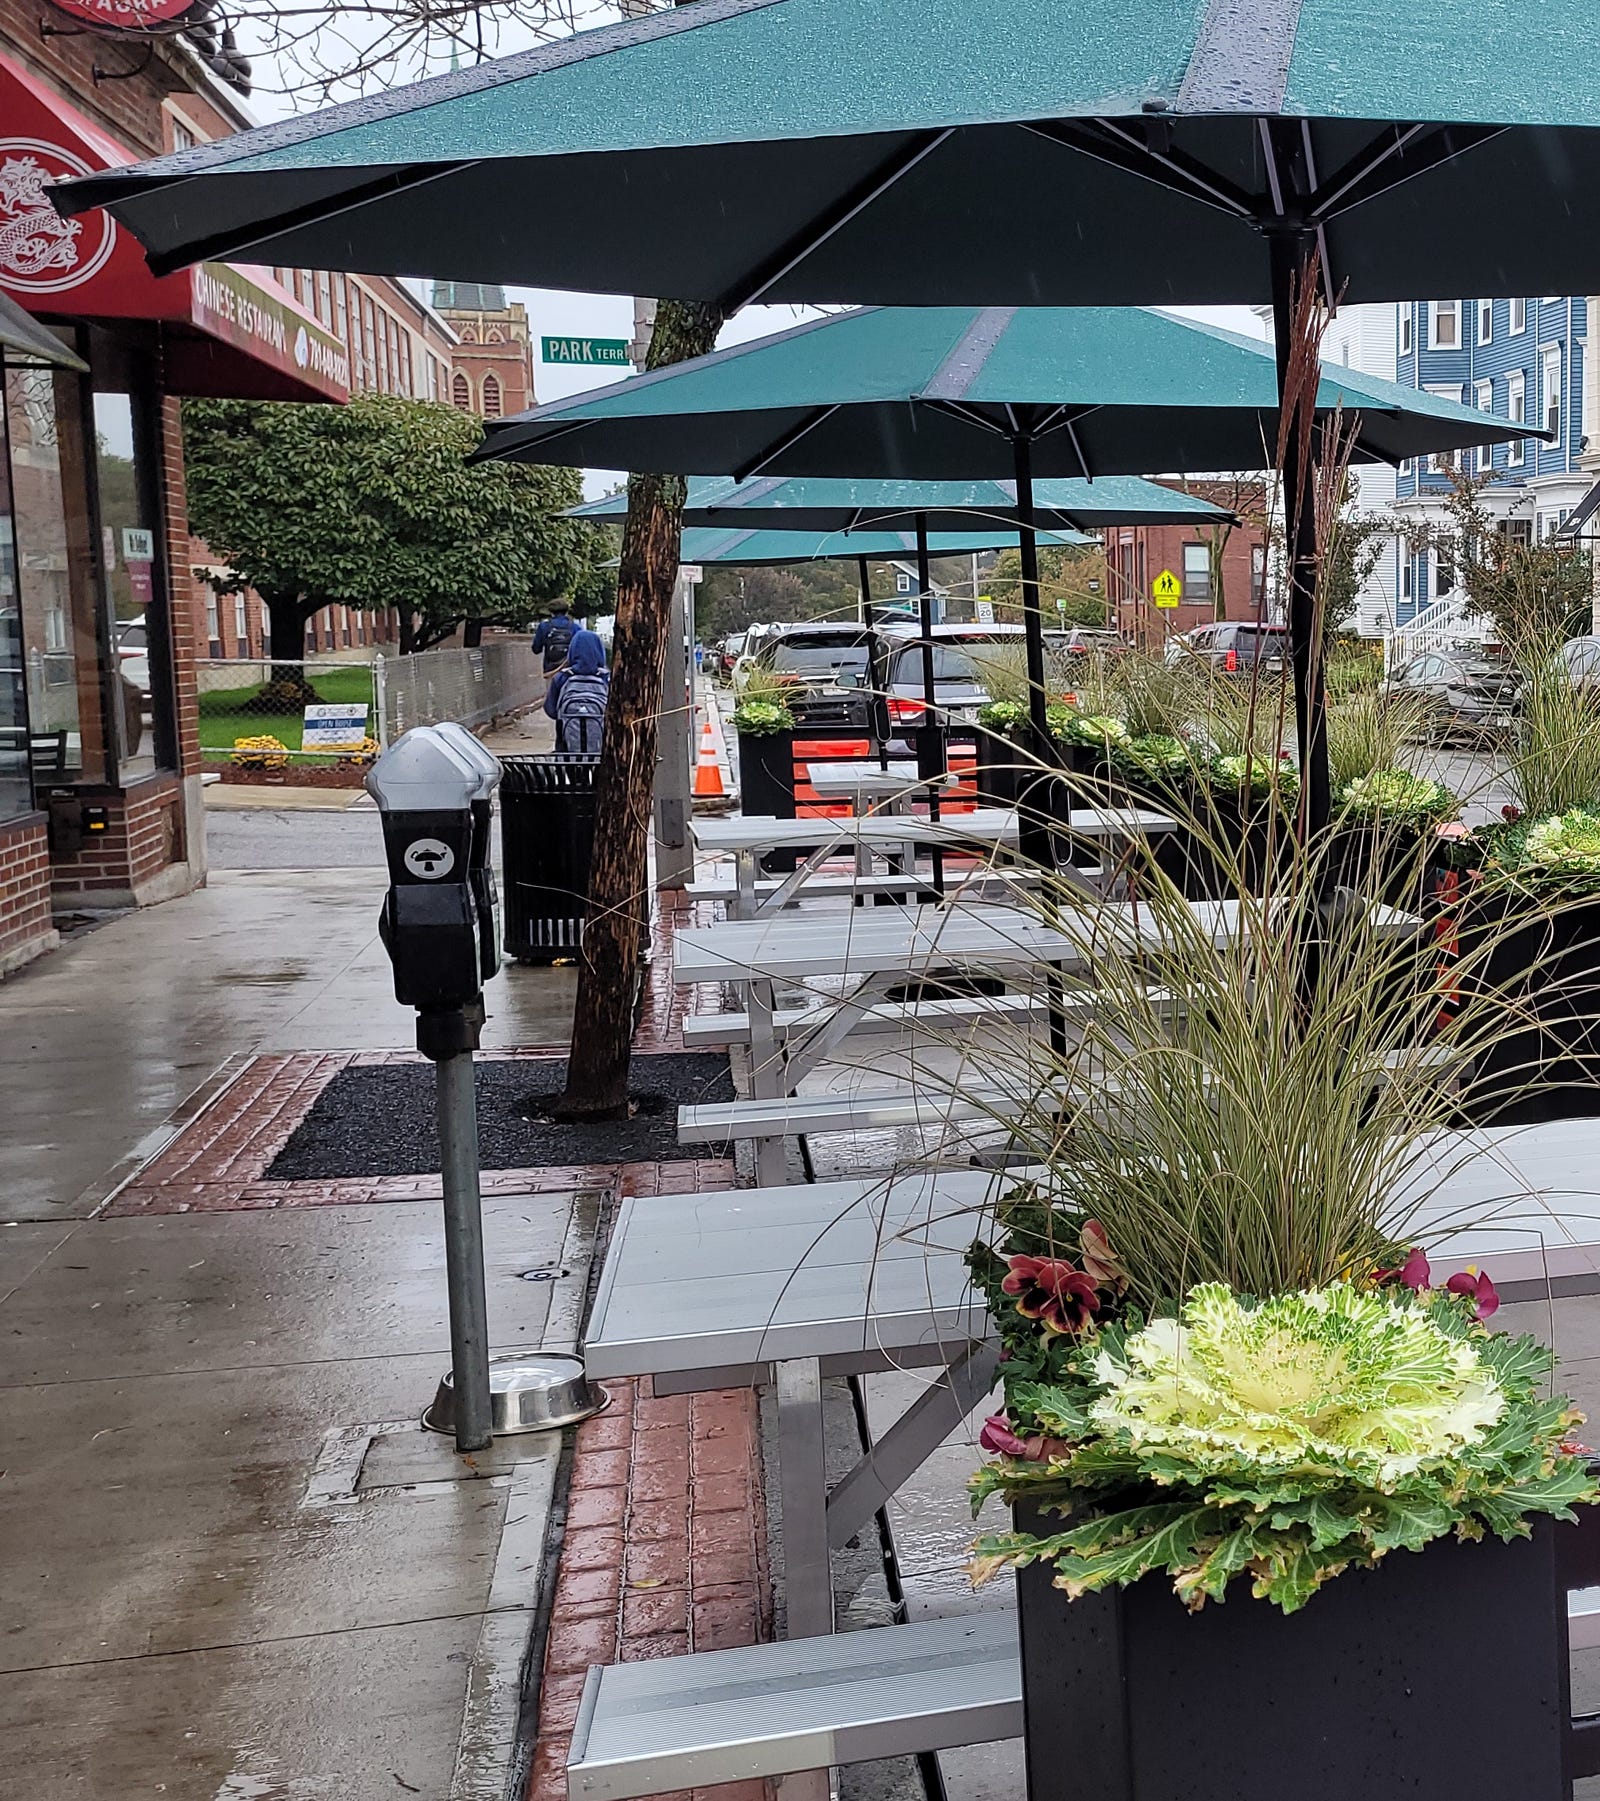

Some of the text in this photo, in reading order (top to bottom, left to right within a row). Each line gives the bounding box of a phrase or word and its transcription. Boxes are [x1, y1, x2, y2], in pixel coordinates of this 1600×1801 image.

[195, 267, 236, 323] CHINESE
[549, 340, 624, 361] PARK TERR
